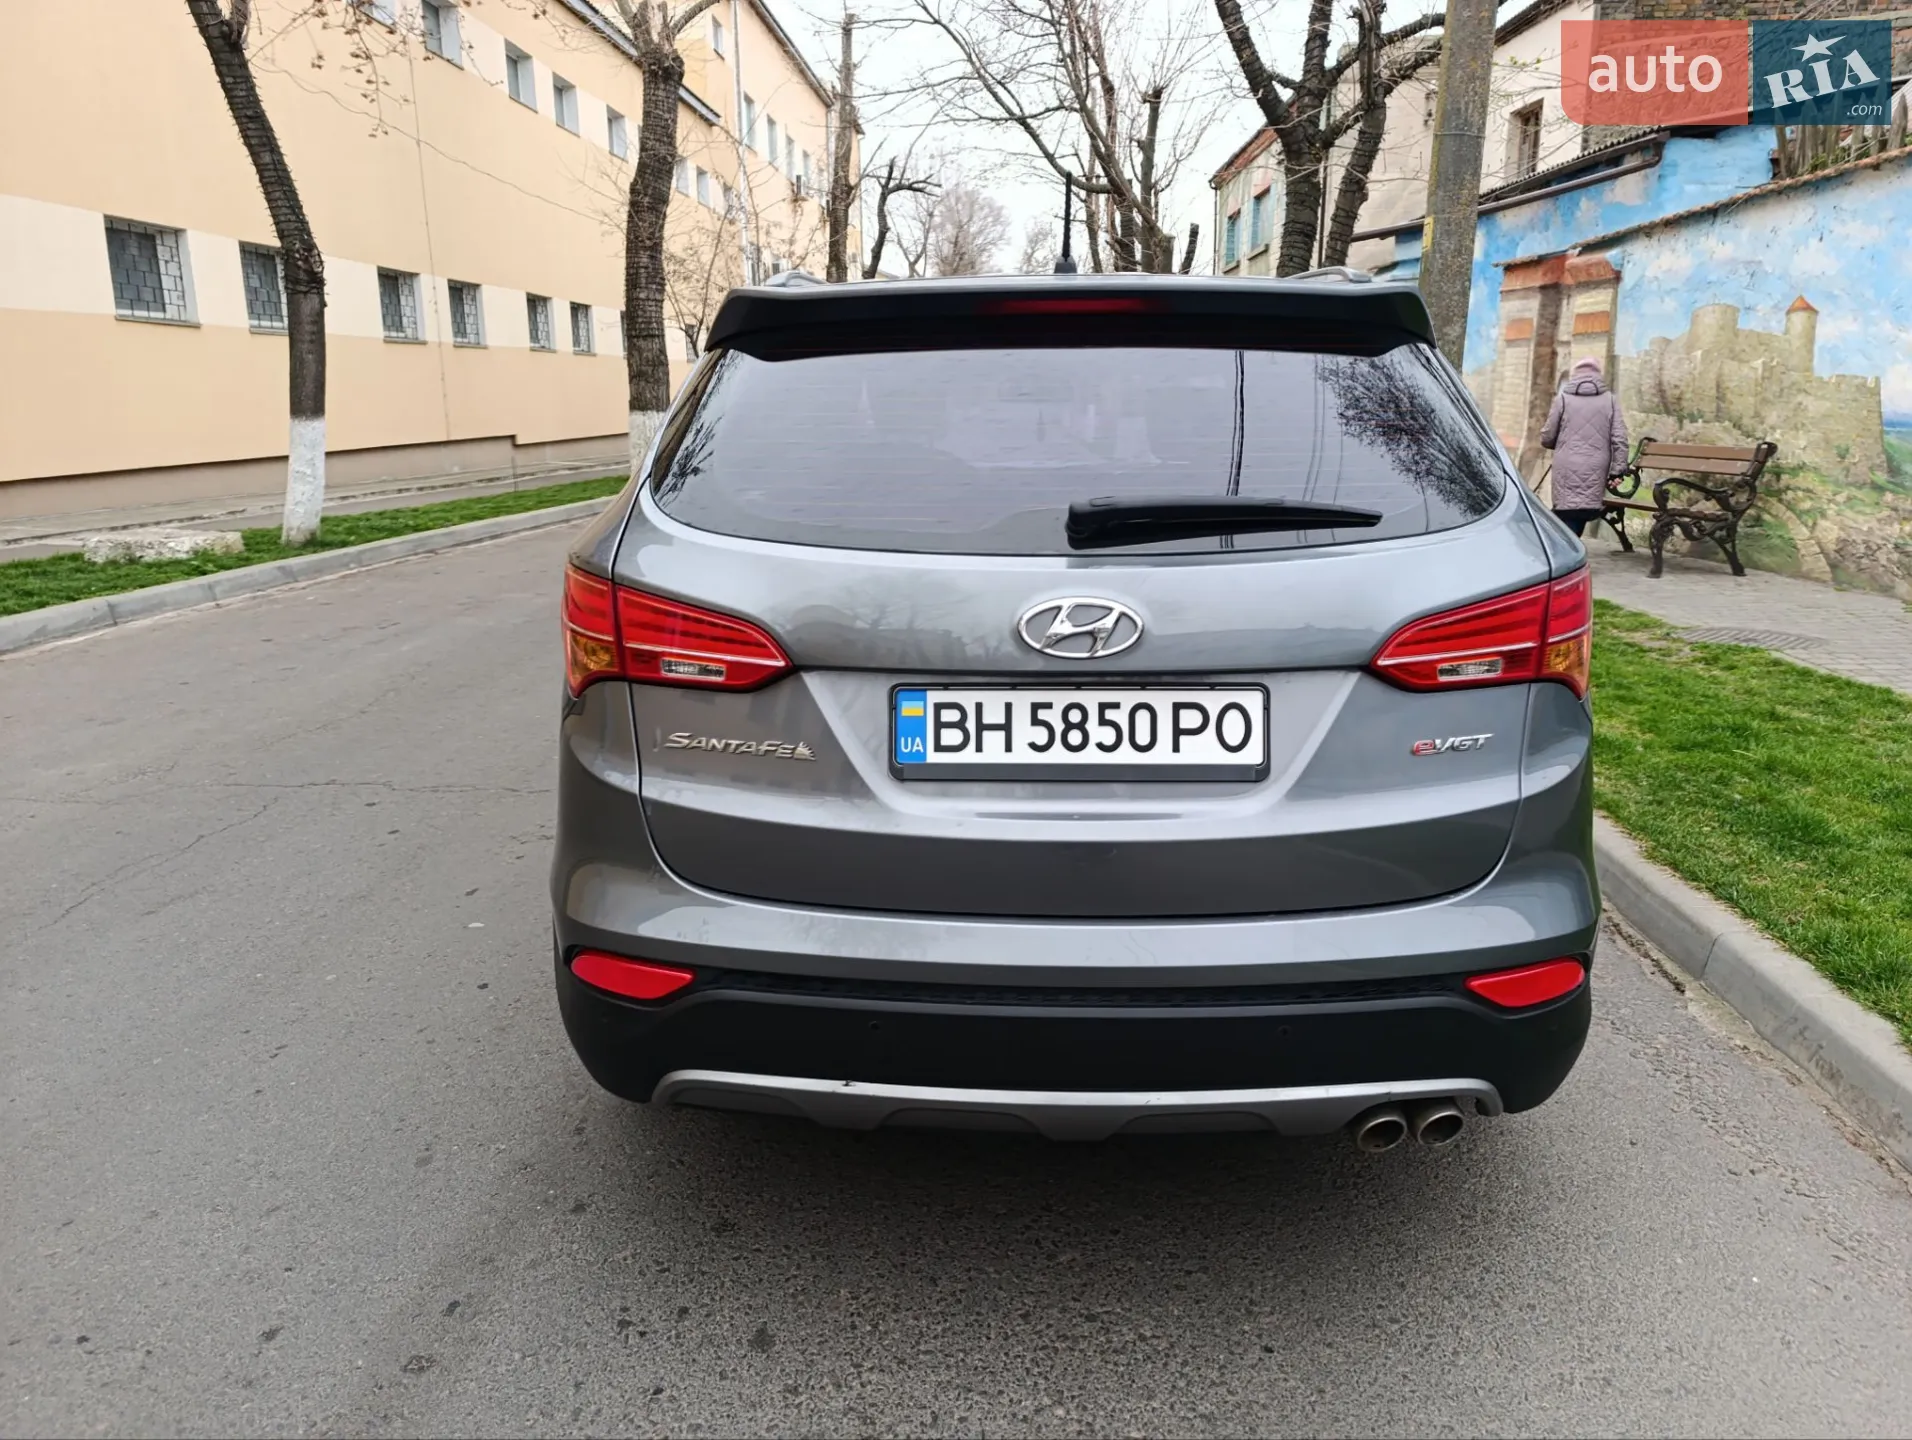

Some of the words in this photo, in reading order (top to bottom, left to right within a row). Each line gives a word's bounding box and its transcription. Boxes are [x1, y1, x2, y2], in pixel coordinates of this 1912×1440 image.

[932, 701, 1013, 753] BH
[1027, 701, 1158, 754] 5850
[1171, 701, 1253, 754] PO
[901, 737, 924, 753] UA
